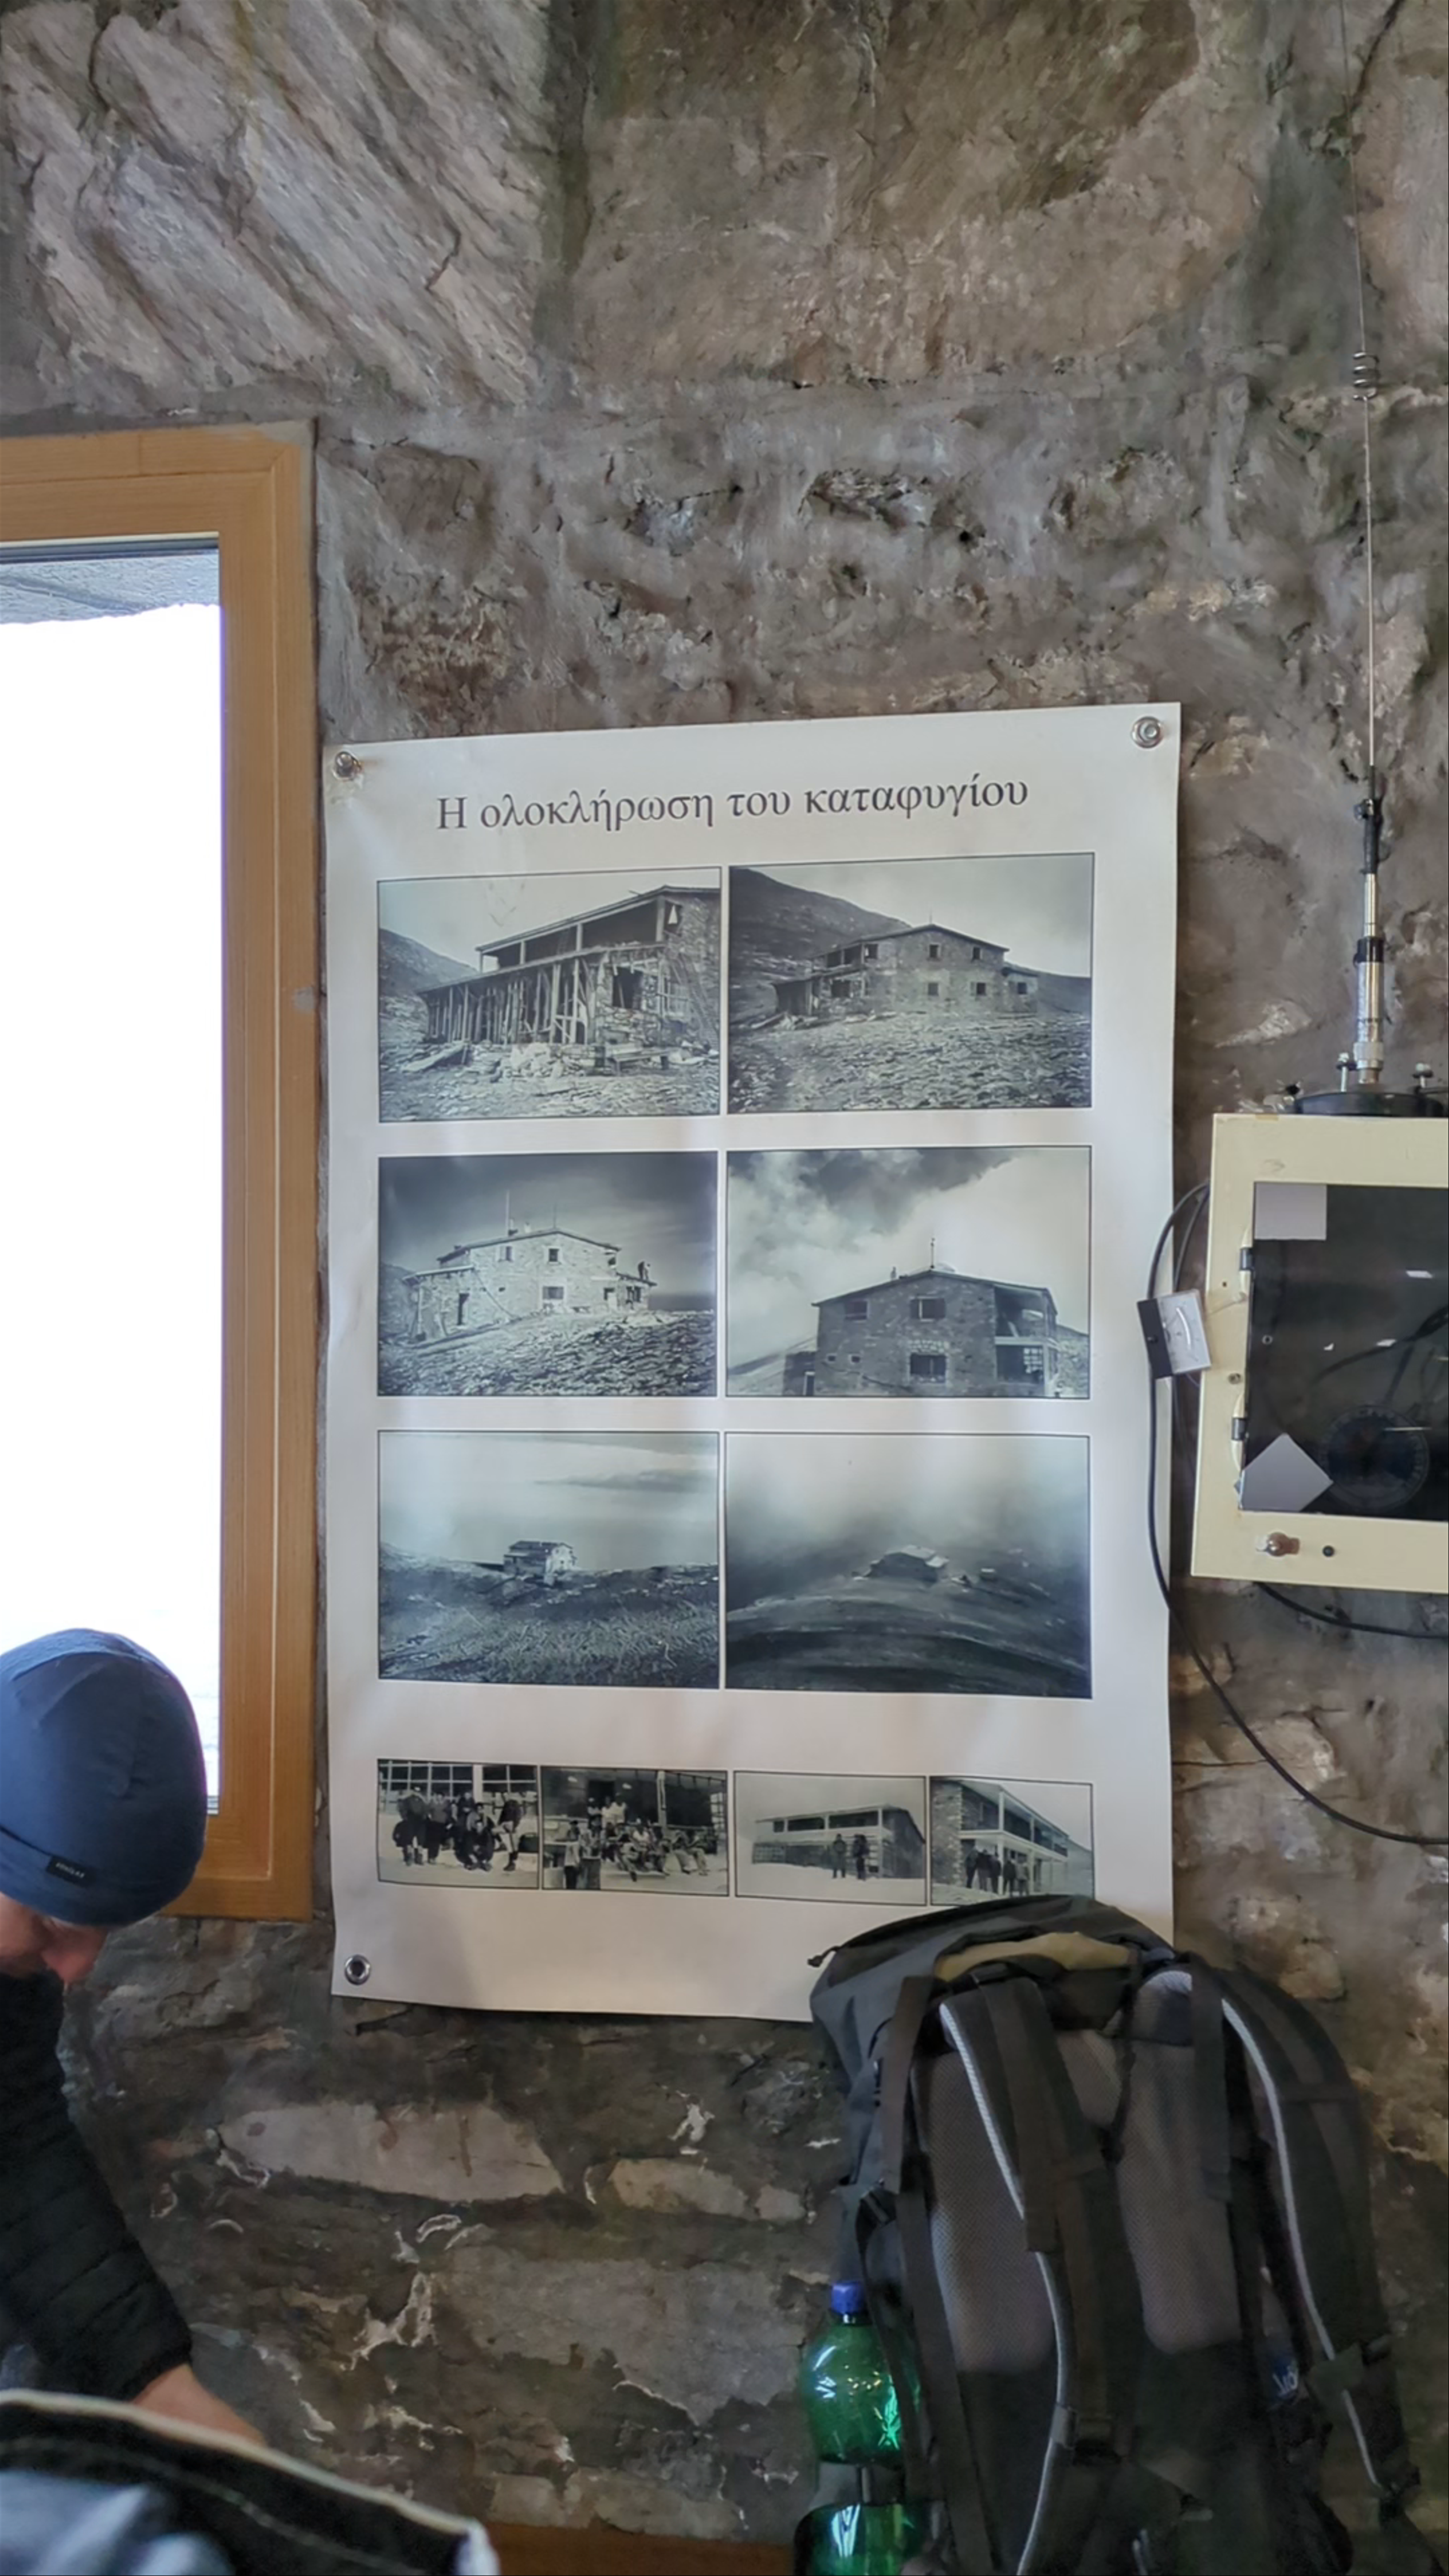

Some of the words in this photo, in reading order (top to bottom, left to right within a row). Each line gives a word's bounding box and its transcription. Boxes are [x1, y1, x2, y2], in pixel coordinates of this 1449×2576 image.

[438, 797, 466, 829] Η
[480, 789, 713, 831] ολοκλήρωση
[727, 792, 790, 817] του
[804, 773, 1028, 819] καταφυγίου
